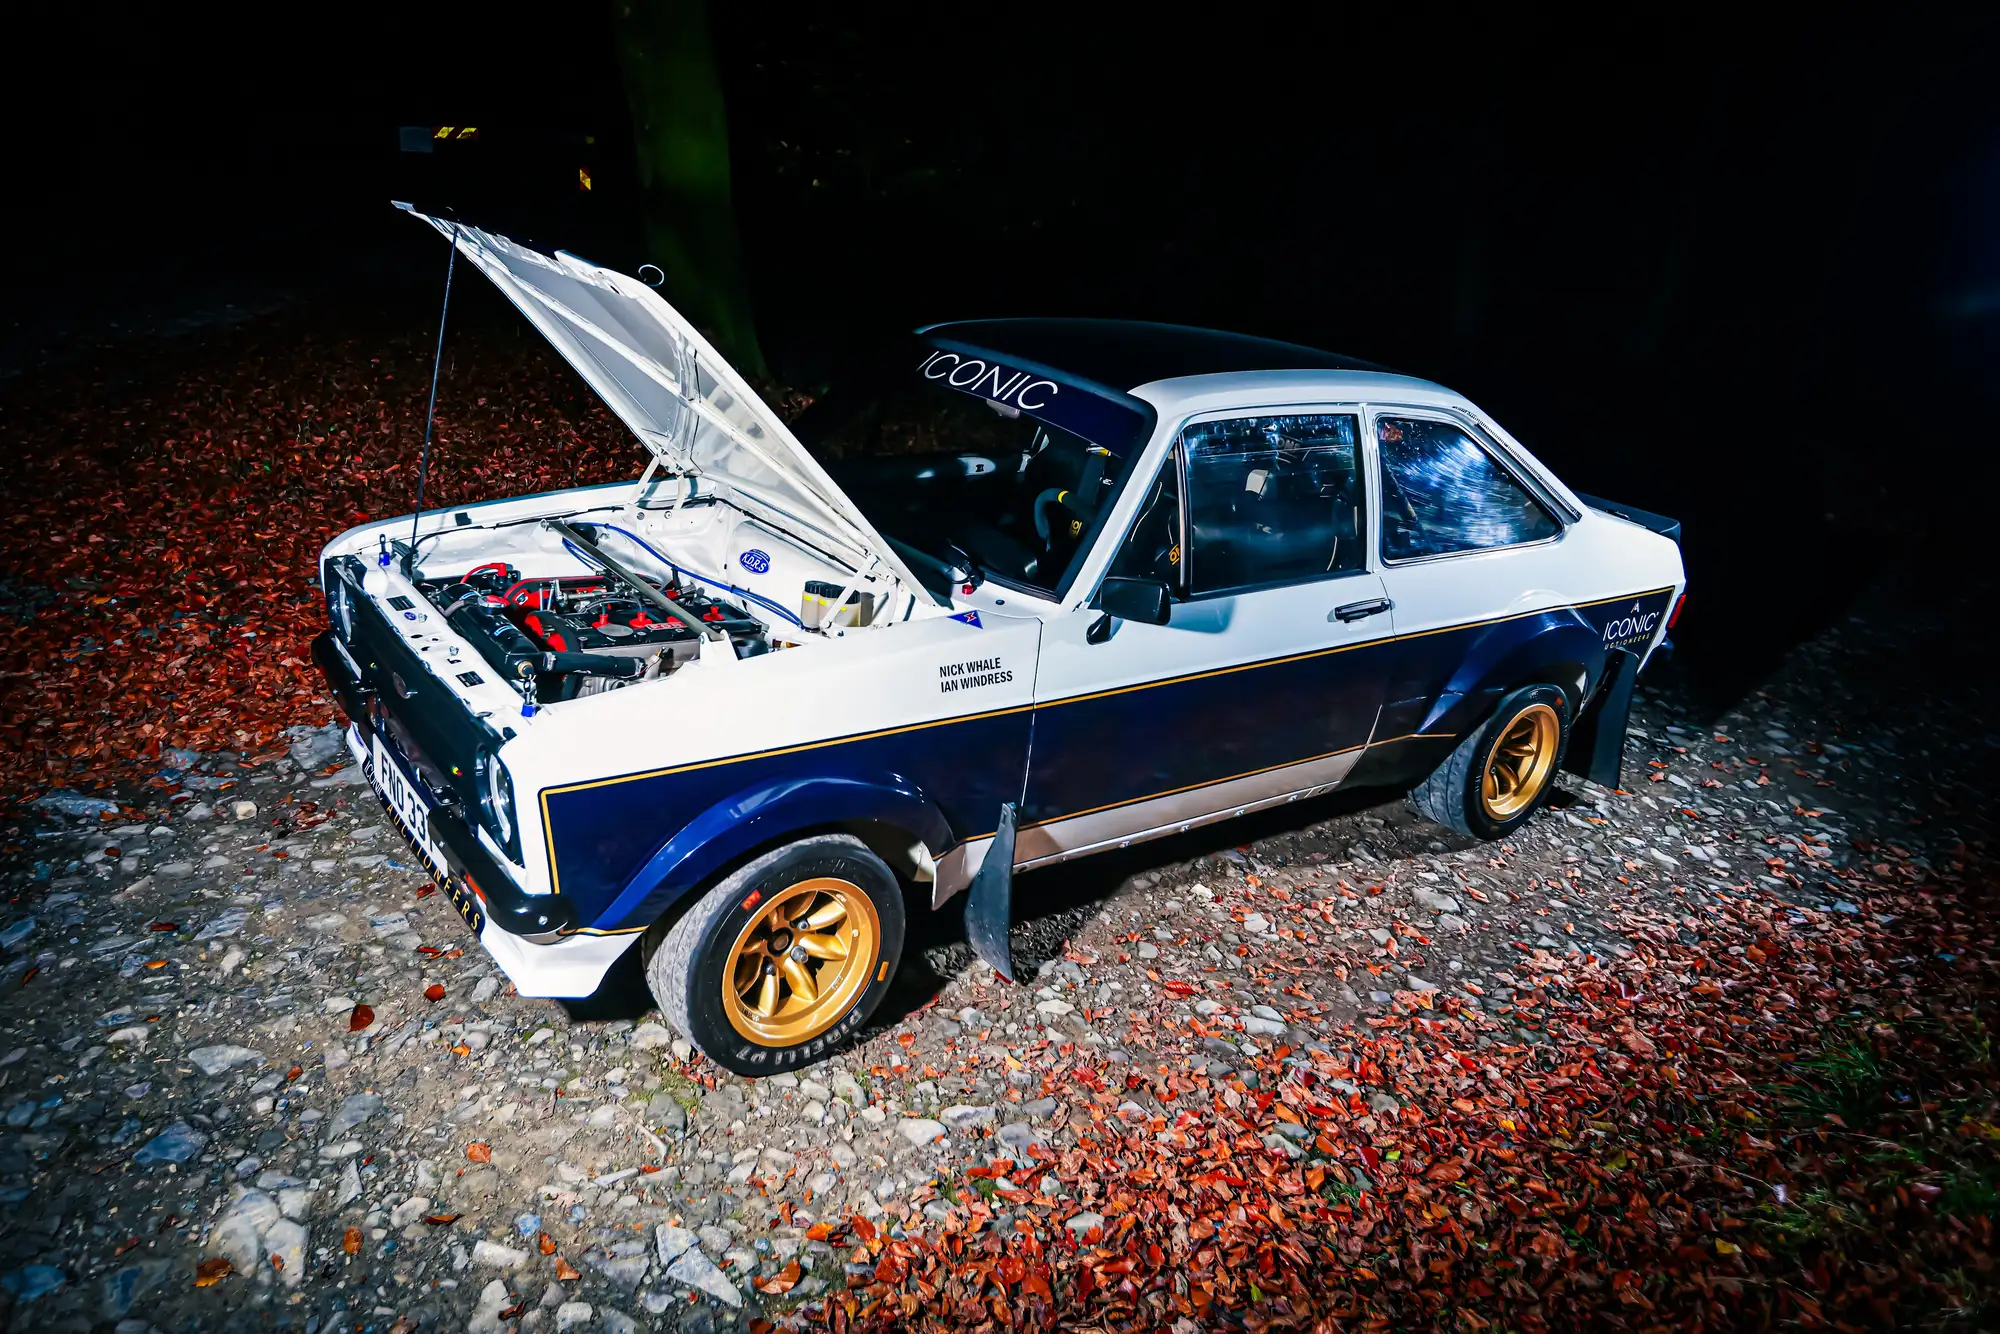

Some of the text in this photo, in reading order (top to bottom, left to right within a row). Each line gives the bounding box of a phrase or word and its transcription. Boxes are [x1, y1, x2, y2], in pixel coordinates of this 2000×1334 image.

[916, 351, 1058, 410] ICONIC
[1603, 612, 1656, 641] ICONIC
[940, 657, 1001, 678] NICK WHALE
[941, 670, 1013, 693] IAN WINDRESS
